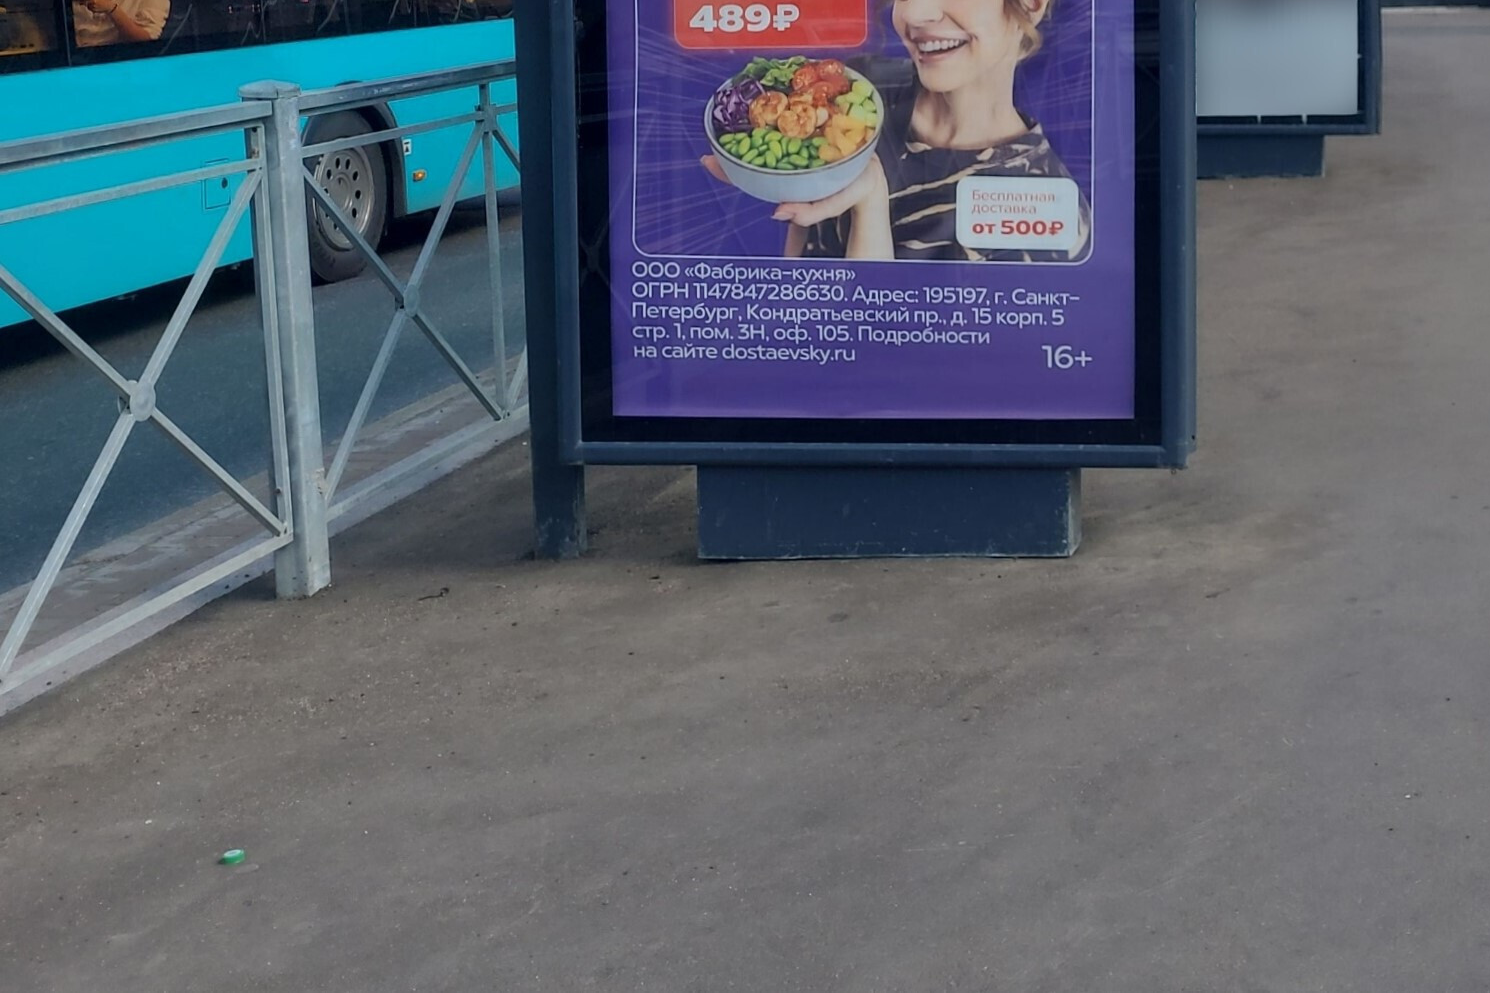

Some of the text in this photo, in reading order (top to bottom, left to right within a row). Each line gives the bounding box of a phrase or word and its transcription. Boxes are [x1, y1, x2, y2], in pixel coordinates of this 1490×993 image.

[972, 189, 1056, 202] Бесплатная
[971, 204, 1037, 215] доставка
[972, 223, 996, 234] от
[631, 261, 681, 279] ООО
[631, 281, 1080, 306] ОГРН 1147847286630. Адрес: 195197, г. Санкт-
[631, 302, 1065, 329] Петербург, Кондратьевский пр., д. 15 корп. 5
[632, 325, 670, 342] стр.
[674, 324, 686, 341] 1,
[690, 326, 734, 340] пом.
[773, 325, 812, 345] оф.
[816, 325, 853, 341] 105.
[857, 326, 990, 346] Подробности
[633, 343, 856, 365] на сайте dostaevsky.ru
[1041, 345, 1092, 369] 16+
